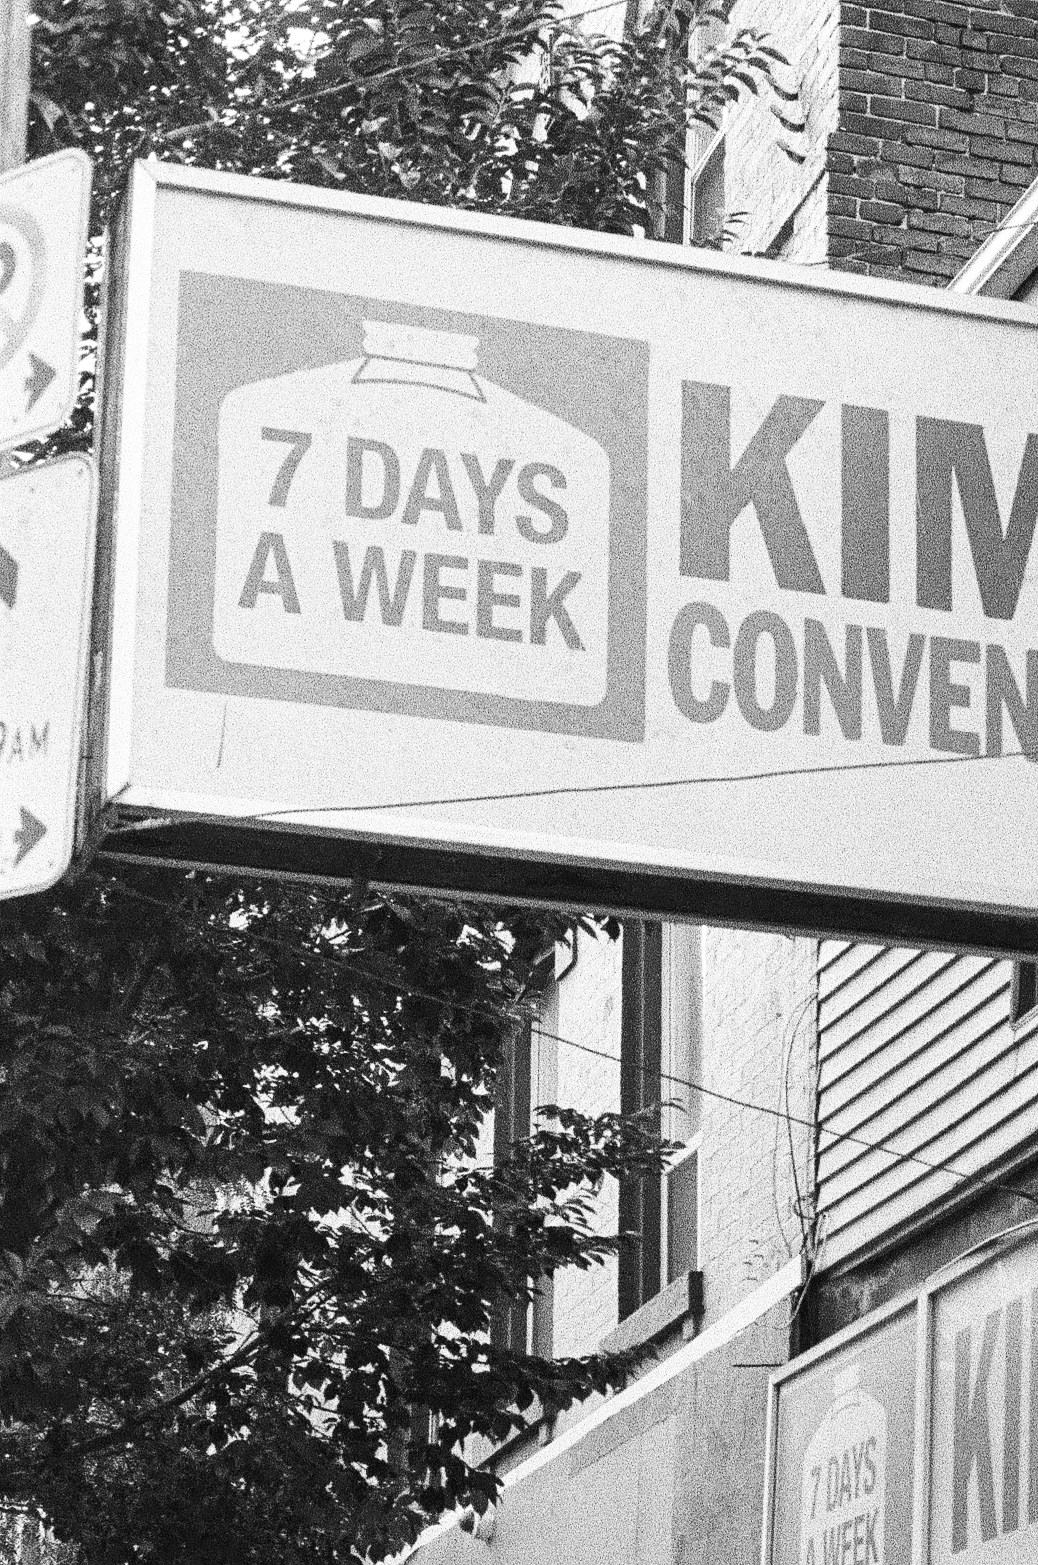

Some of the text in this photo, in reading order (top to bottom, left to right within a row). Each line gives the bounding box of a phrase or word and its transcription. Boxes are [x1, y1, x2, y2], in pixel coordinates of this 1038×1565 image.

[261, 425, 570, 544] 7 DAYS
[237, 530, 587, 652] A WEEK
[809, 1435, 878, 1521] 7 DAYS
